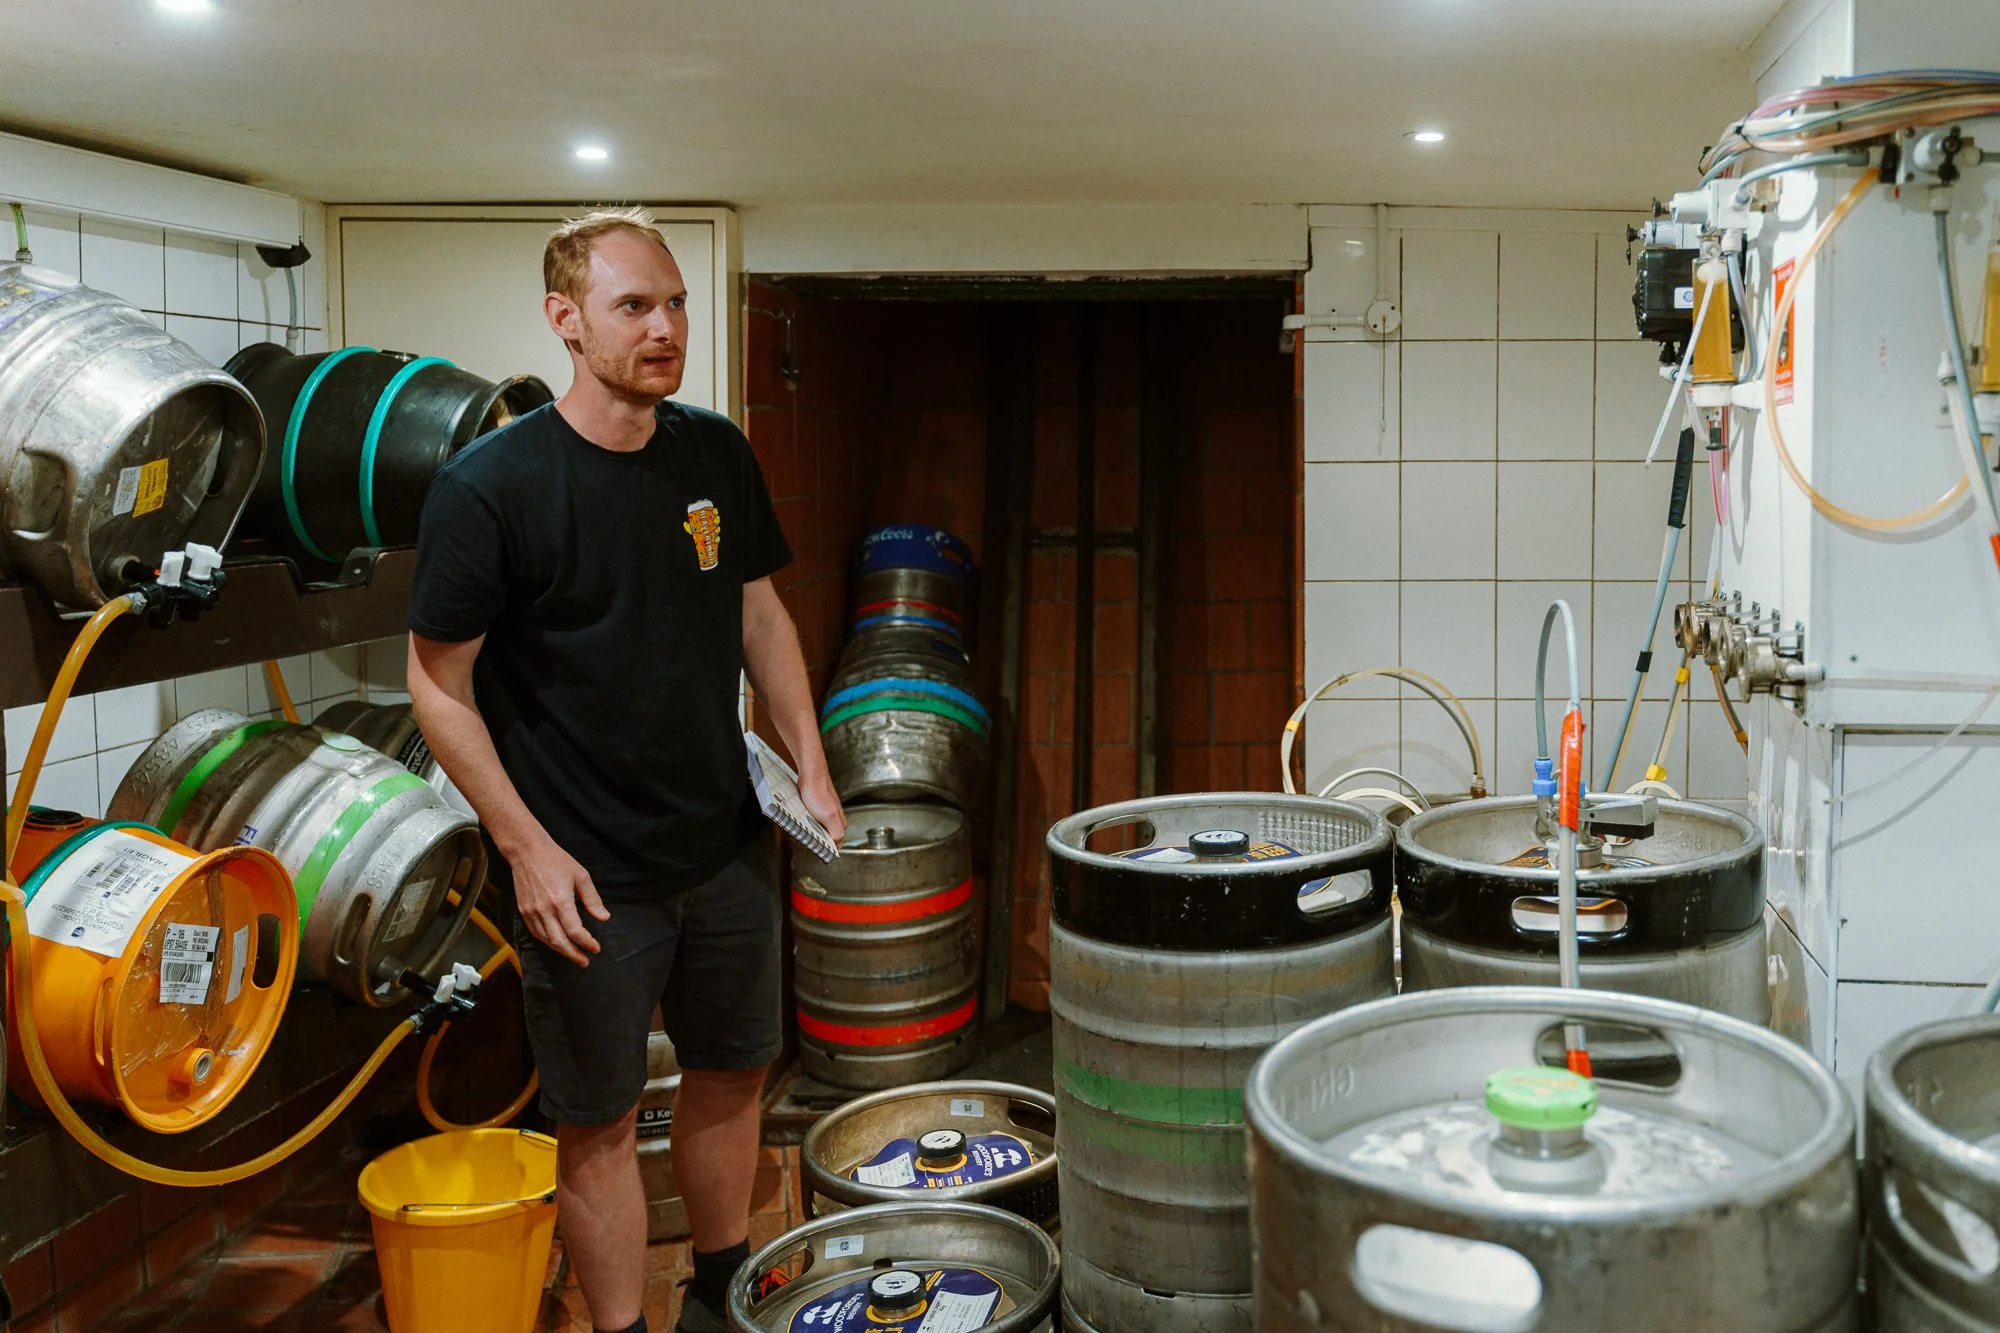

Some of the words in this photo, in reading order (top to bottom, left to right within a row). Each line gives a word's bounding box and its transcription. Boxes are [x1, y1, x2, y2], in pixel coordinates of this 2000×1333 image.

[123, 847, 169, 867] FRAGILE!
[60, 913, 81, 925] Code:
[82, 919, 110, 934] Tracking
